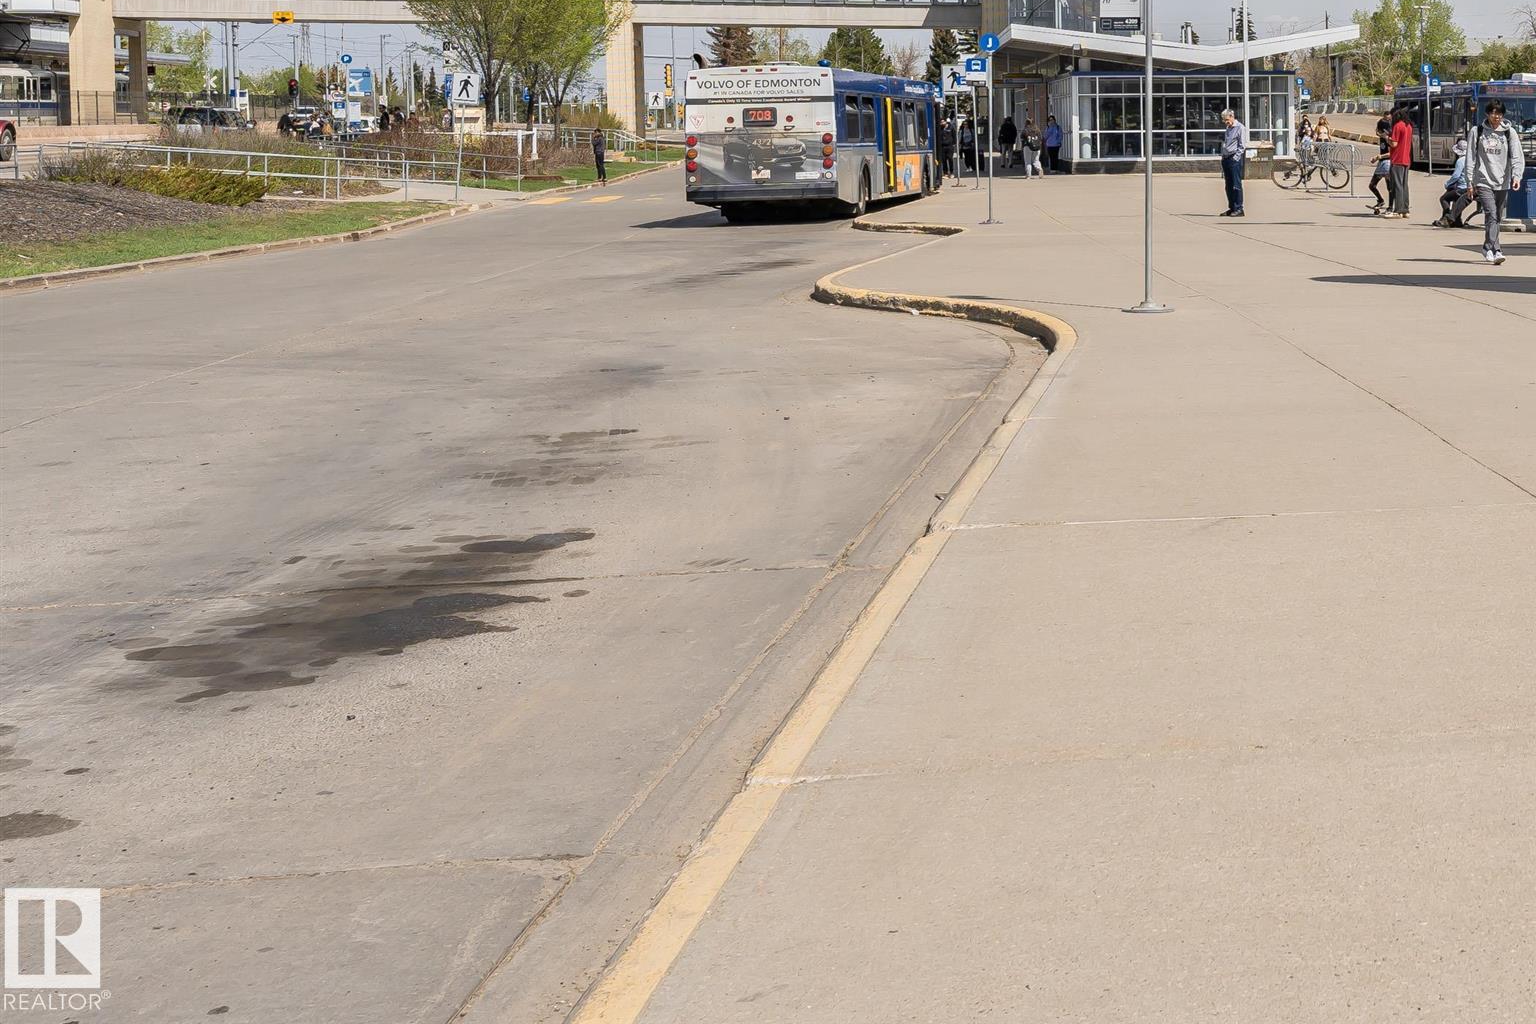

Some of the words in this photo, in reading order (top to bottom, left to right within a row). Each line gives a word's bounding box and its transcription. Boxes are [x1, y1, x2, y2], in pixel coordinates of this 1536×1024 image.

[986, 37, 993, 48] J
[697, 80, 734, 89] VOLVO
[737, 79, 752, 88] OF
[755, 78, 821, 88] EDMONTON
[749, 110, 773, 121] 708
